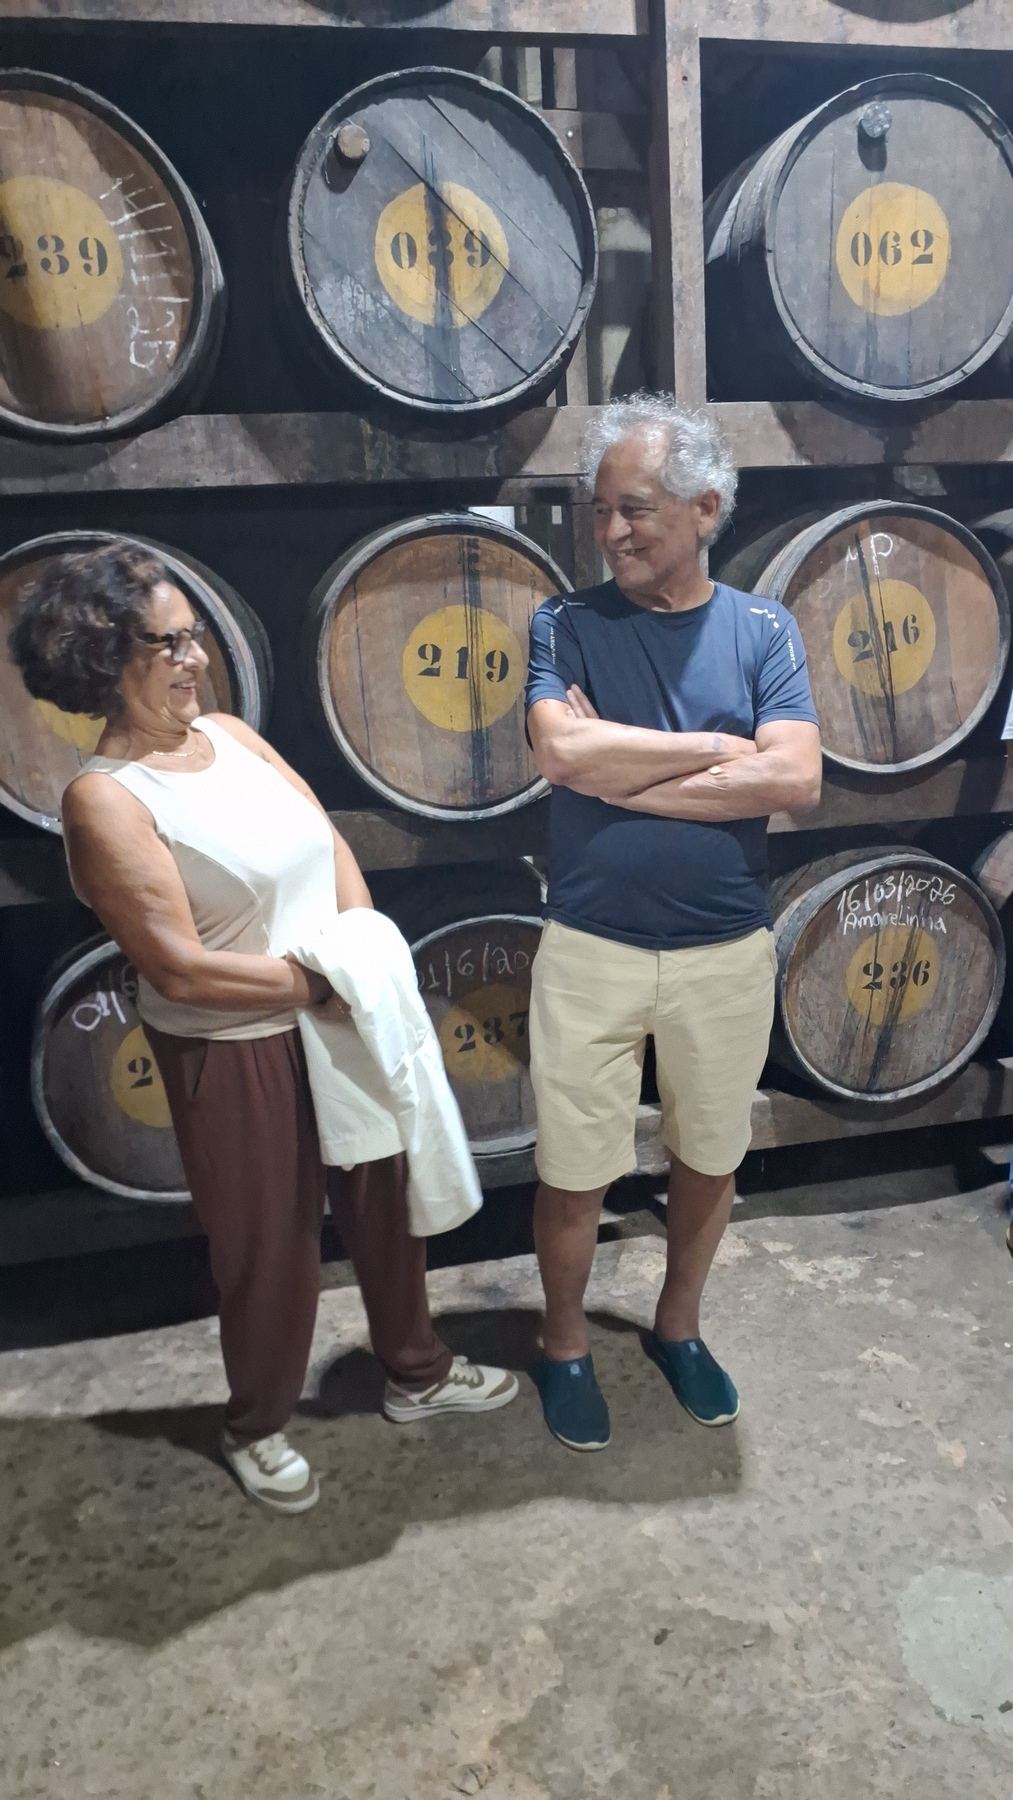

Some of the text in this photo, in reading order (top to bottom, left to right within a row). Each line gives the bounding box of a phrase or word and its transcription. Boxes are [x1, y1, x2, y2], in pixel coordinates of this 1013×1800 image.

[0, 234, 108, 277] 239
[850, 229, 934, 267] 062
[847, 613, 921, 663] 216
[417, 643, 510, 682] 219
[837, 871, 957, 922] 16/03/2026
[862, 959, 931, 991] 236
[455, 1010, 530, 1053] 237
